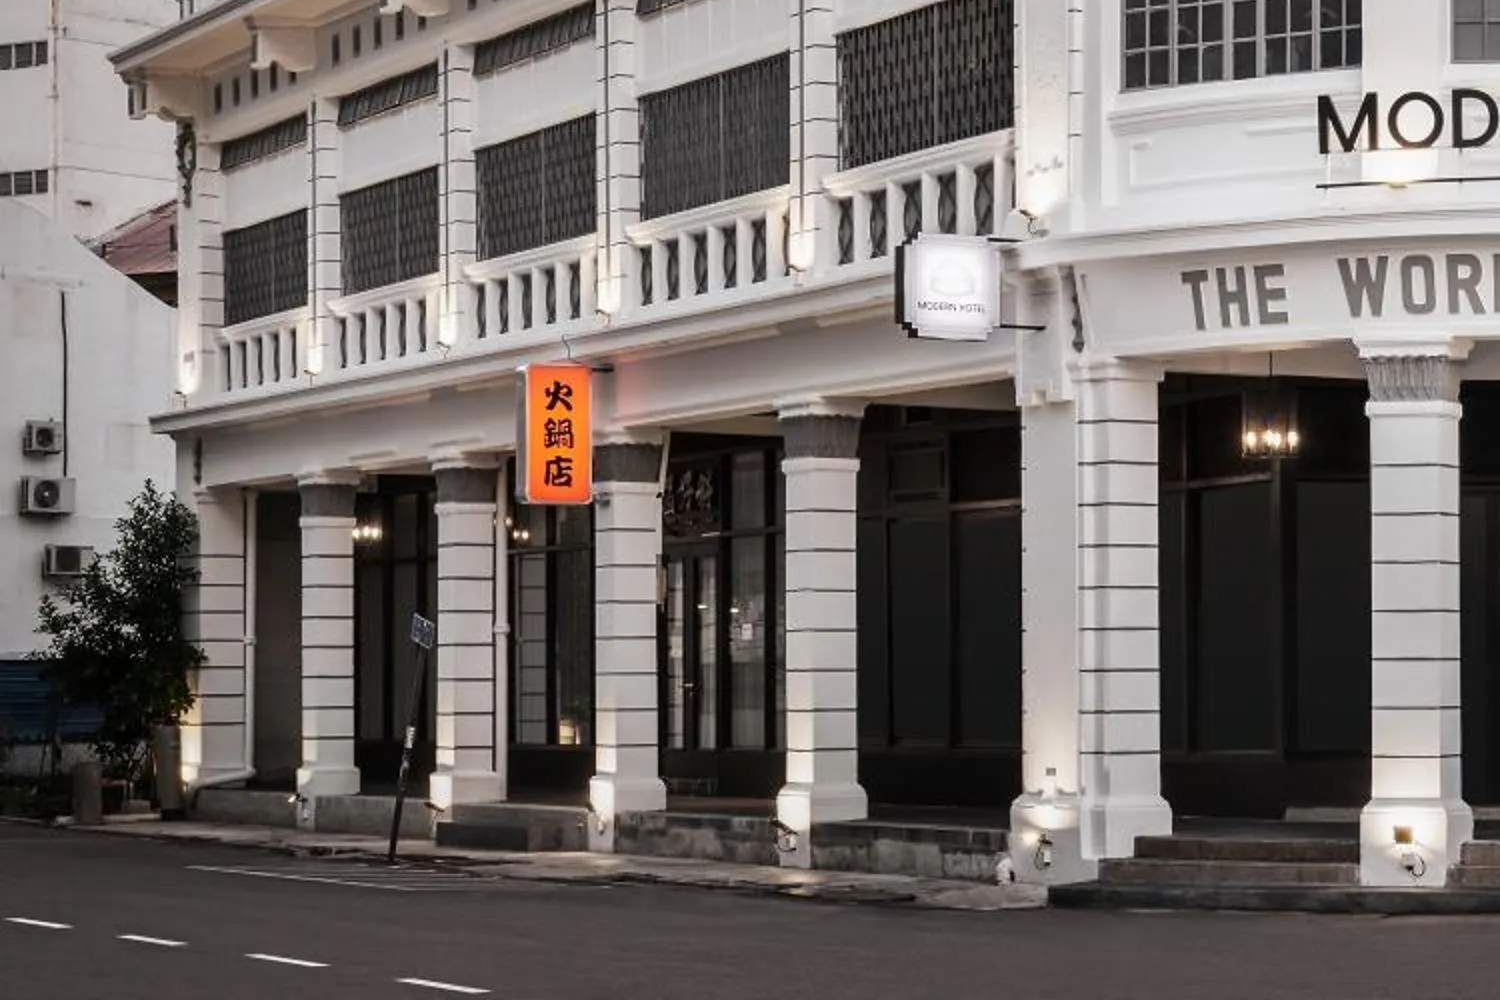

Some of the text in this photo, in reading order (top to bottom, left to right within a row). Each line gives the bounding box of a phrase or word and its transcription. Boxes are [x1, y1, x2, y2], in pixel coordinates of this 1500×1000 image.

[1181, 263, 1290, 331] THE
[543, 380, 574, 487] 火鍋店
